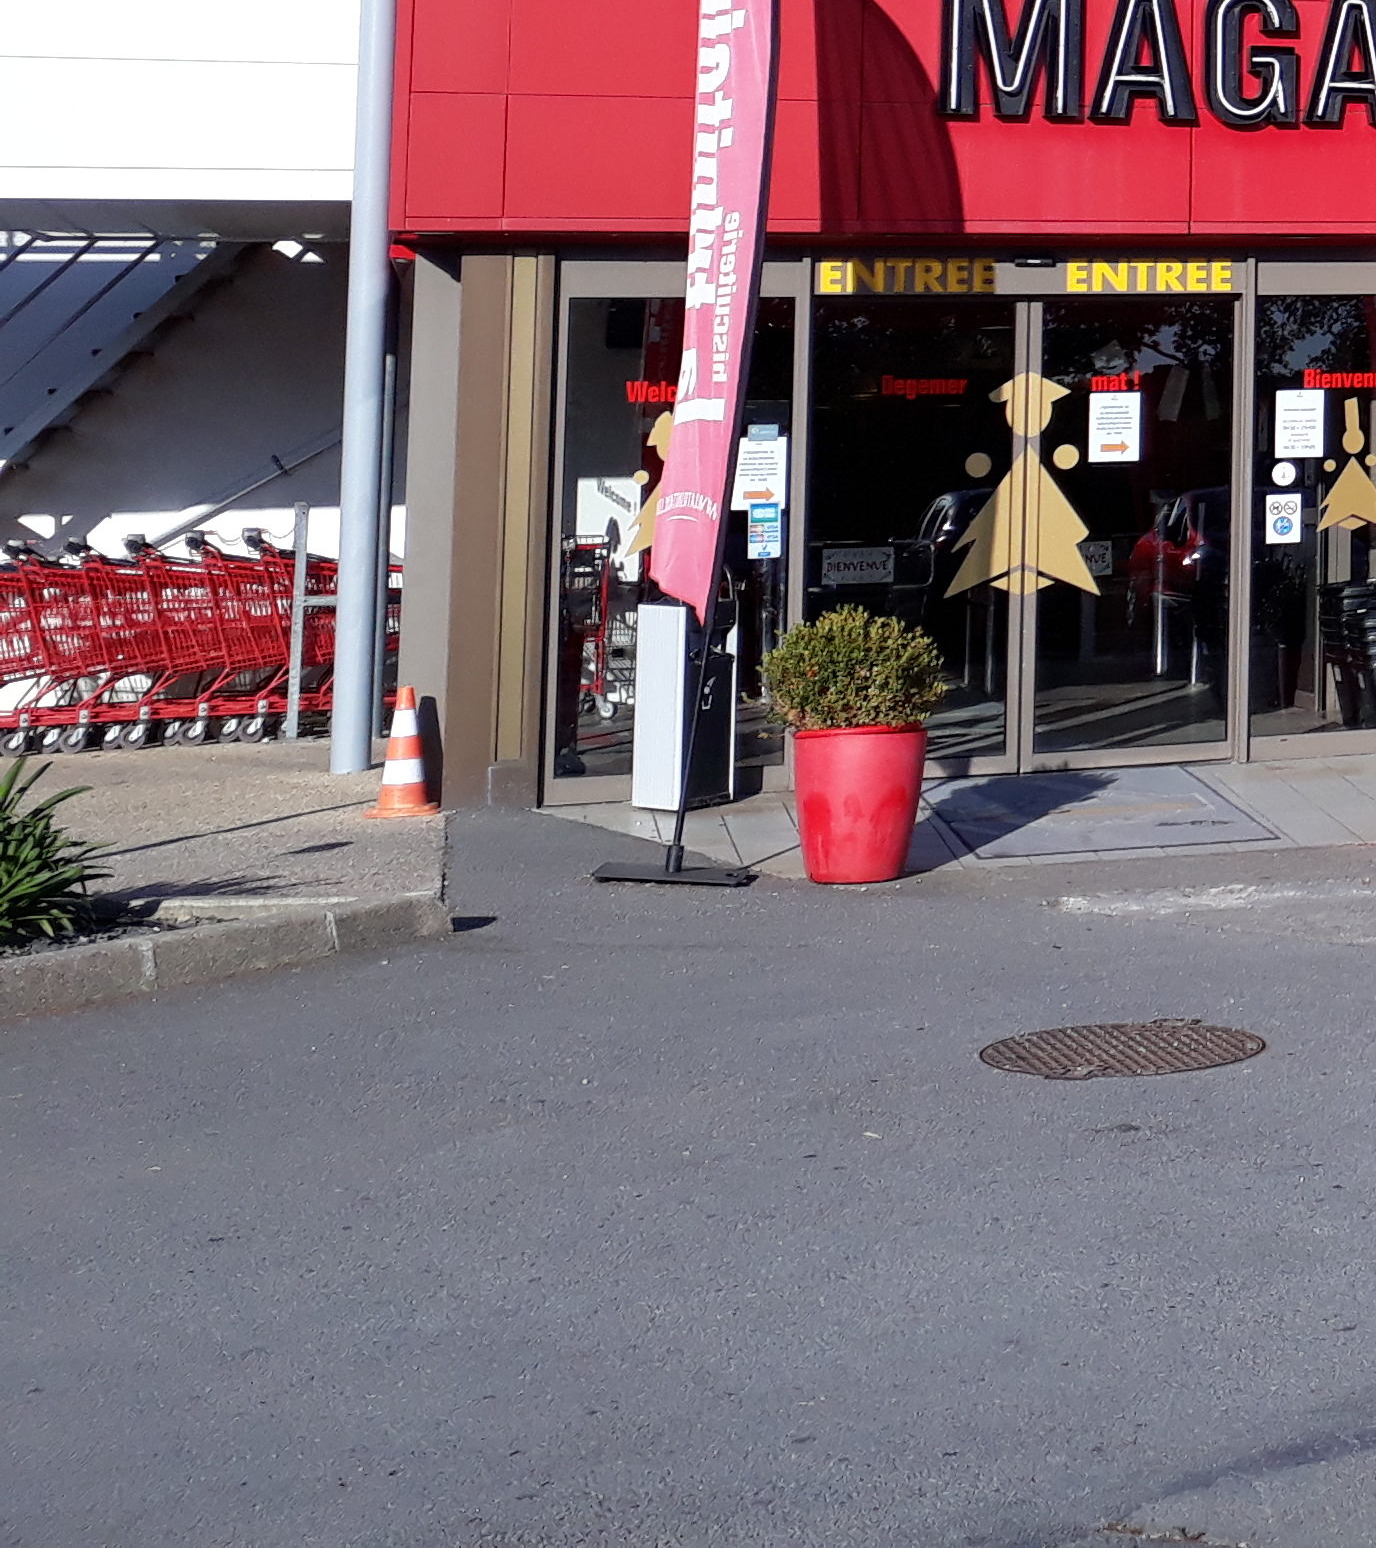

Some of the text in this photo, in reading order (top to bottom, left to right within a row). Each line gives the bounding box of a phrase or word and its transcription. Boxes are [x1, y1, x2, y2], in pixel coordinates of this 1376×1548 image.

[819, 257, 996, 294] ENTREE
[1065, 260, 1233, 293] ENTREE
[626, 380, 677, 403] Welc
[881, 375, 969, 400] Degemer
[1091, 372, 1127, 391] mat
